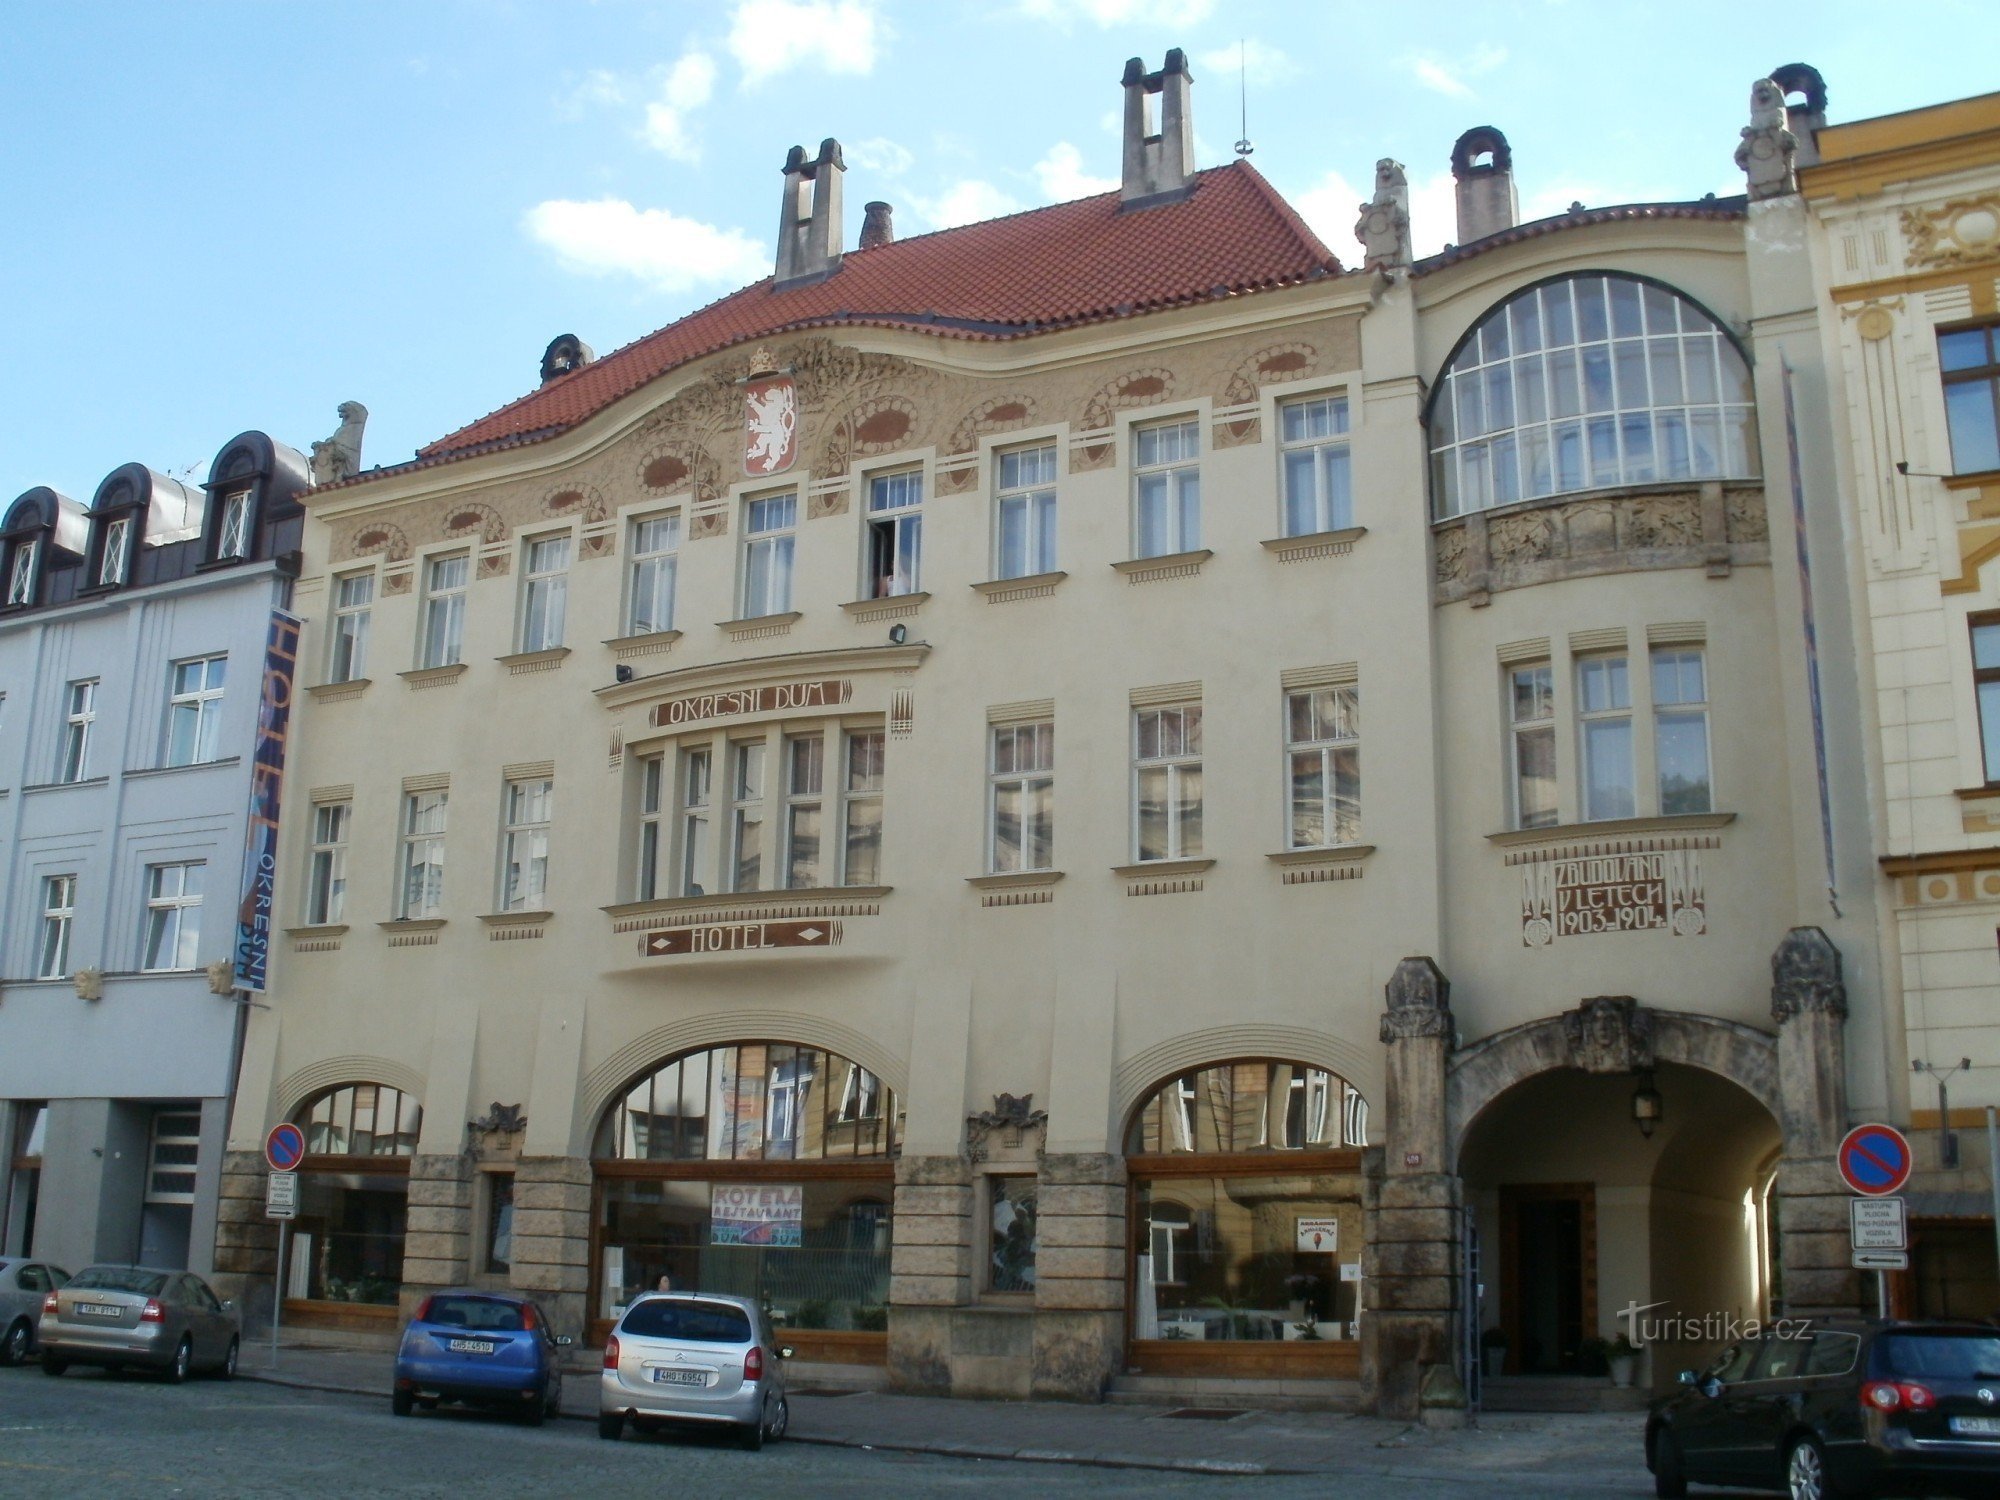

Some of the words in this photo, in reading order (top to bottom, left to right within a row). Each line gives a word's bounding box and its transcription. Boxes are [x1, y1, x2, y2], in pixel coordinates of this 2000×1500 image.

[250, 617, 300, 830] HOTEL
[1555, 855, 1664, 887] ZBUDOVANO
[1558, 891, 1571, 912] V
[1576, 882, 1664, 911] LETECH
[691, 923, 775, 953] HOTEL
[714, 1207, 800, 1218] RESTAURANT
